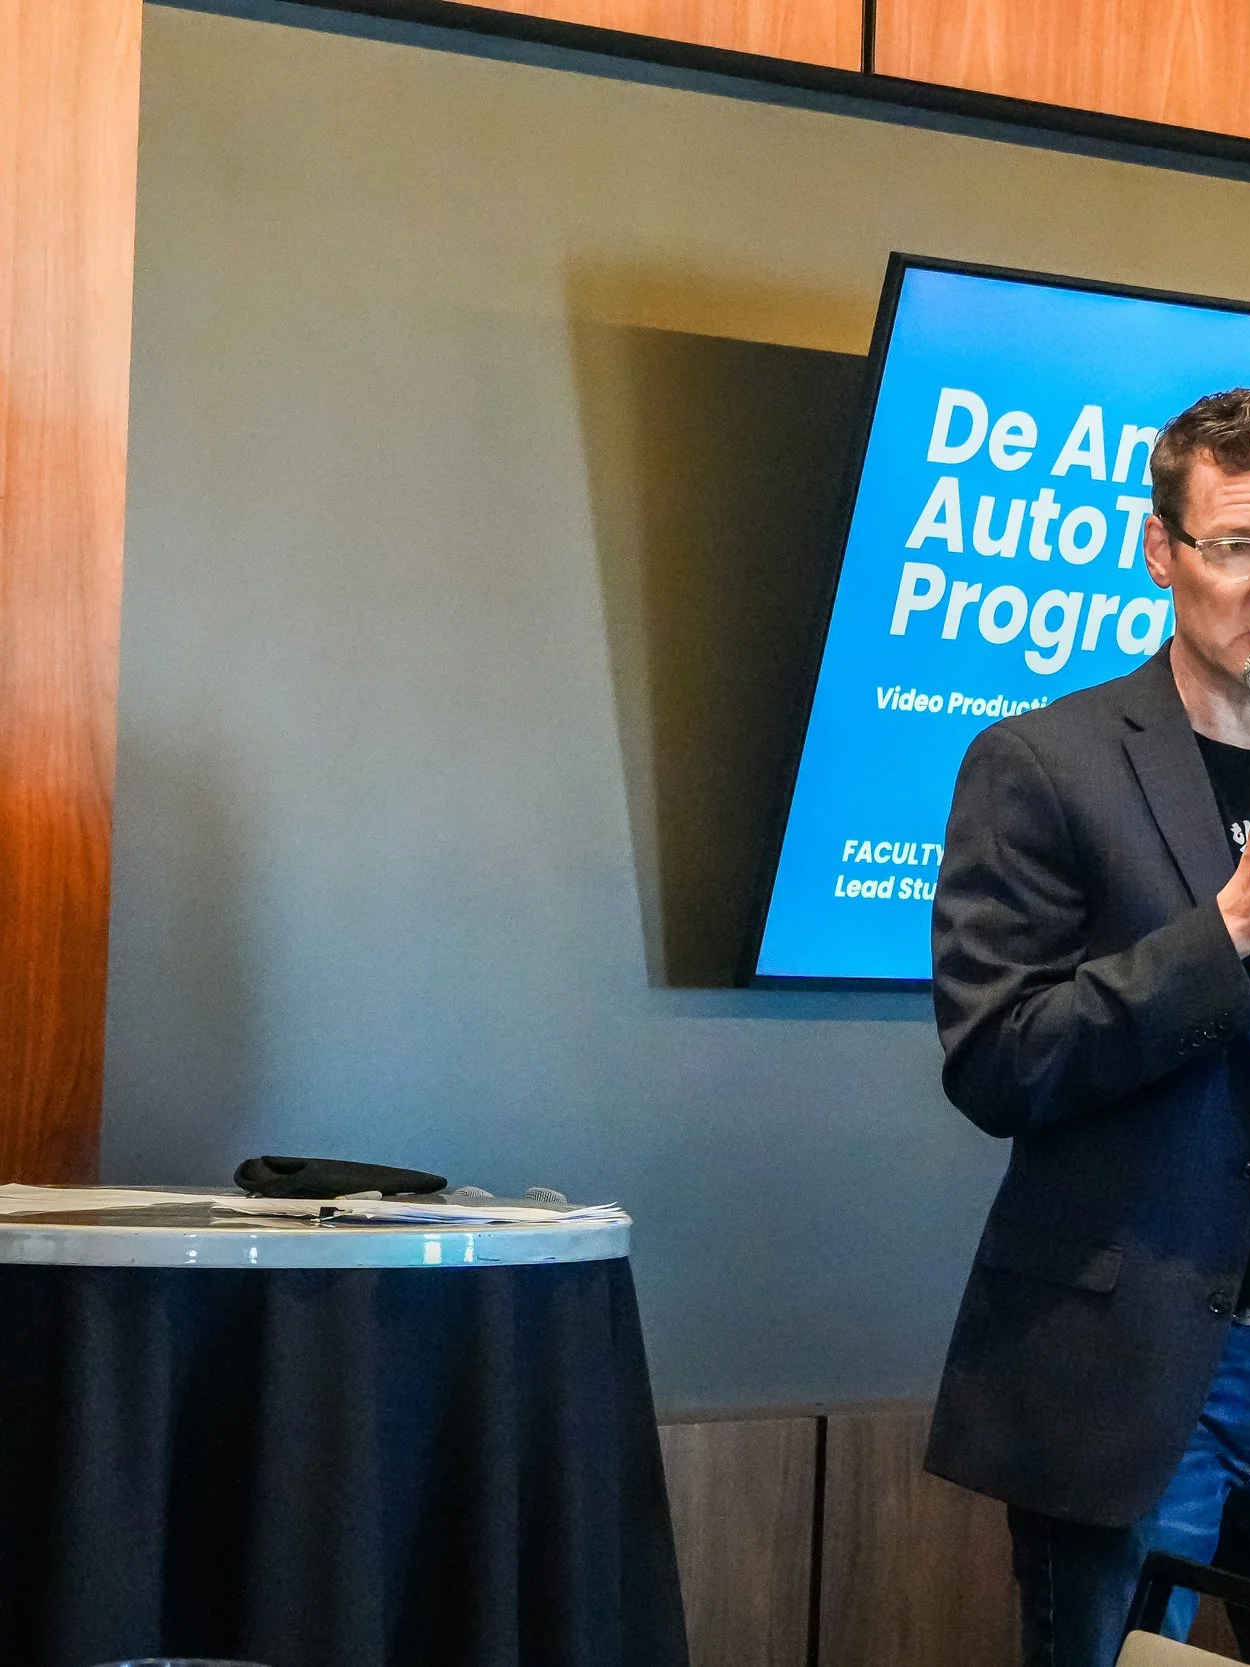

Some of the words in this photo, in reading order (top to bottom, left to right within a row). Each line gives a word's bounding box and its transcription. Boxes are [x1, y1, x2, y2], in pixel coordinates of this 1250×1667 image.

[927, 387, 1038, 471] De
[905, 476, 1154, 569] AutoT
[889, 561, 1175, 675] Progra
[876, 686, 944, 713] Video
[841, 839, 944, 866] FACULTY
[834, 875, 896, 899] Lead
[898, 876, 936, 901] Stu
